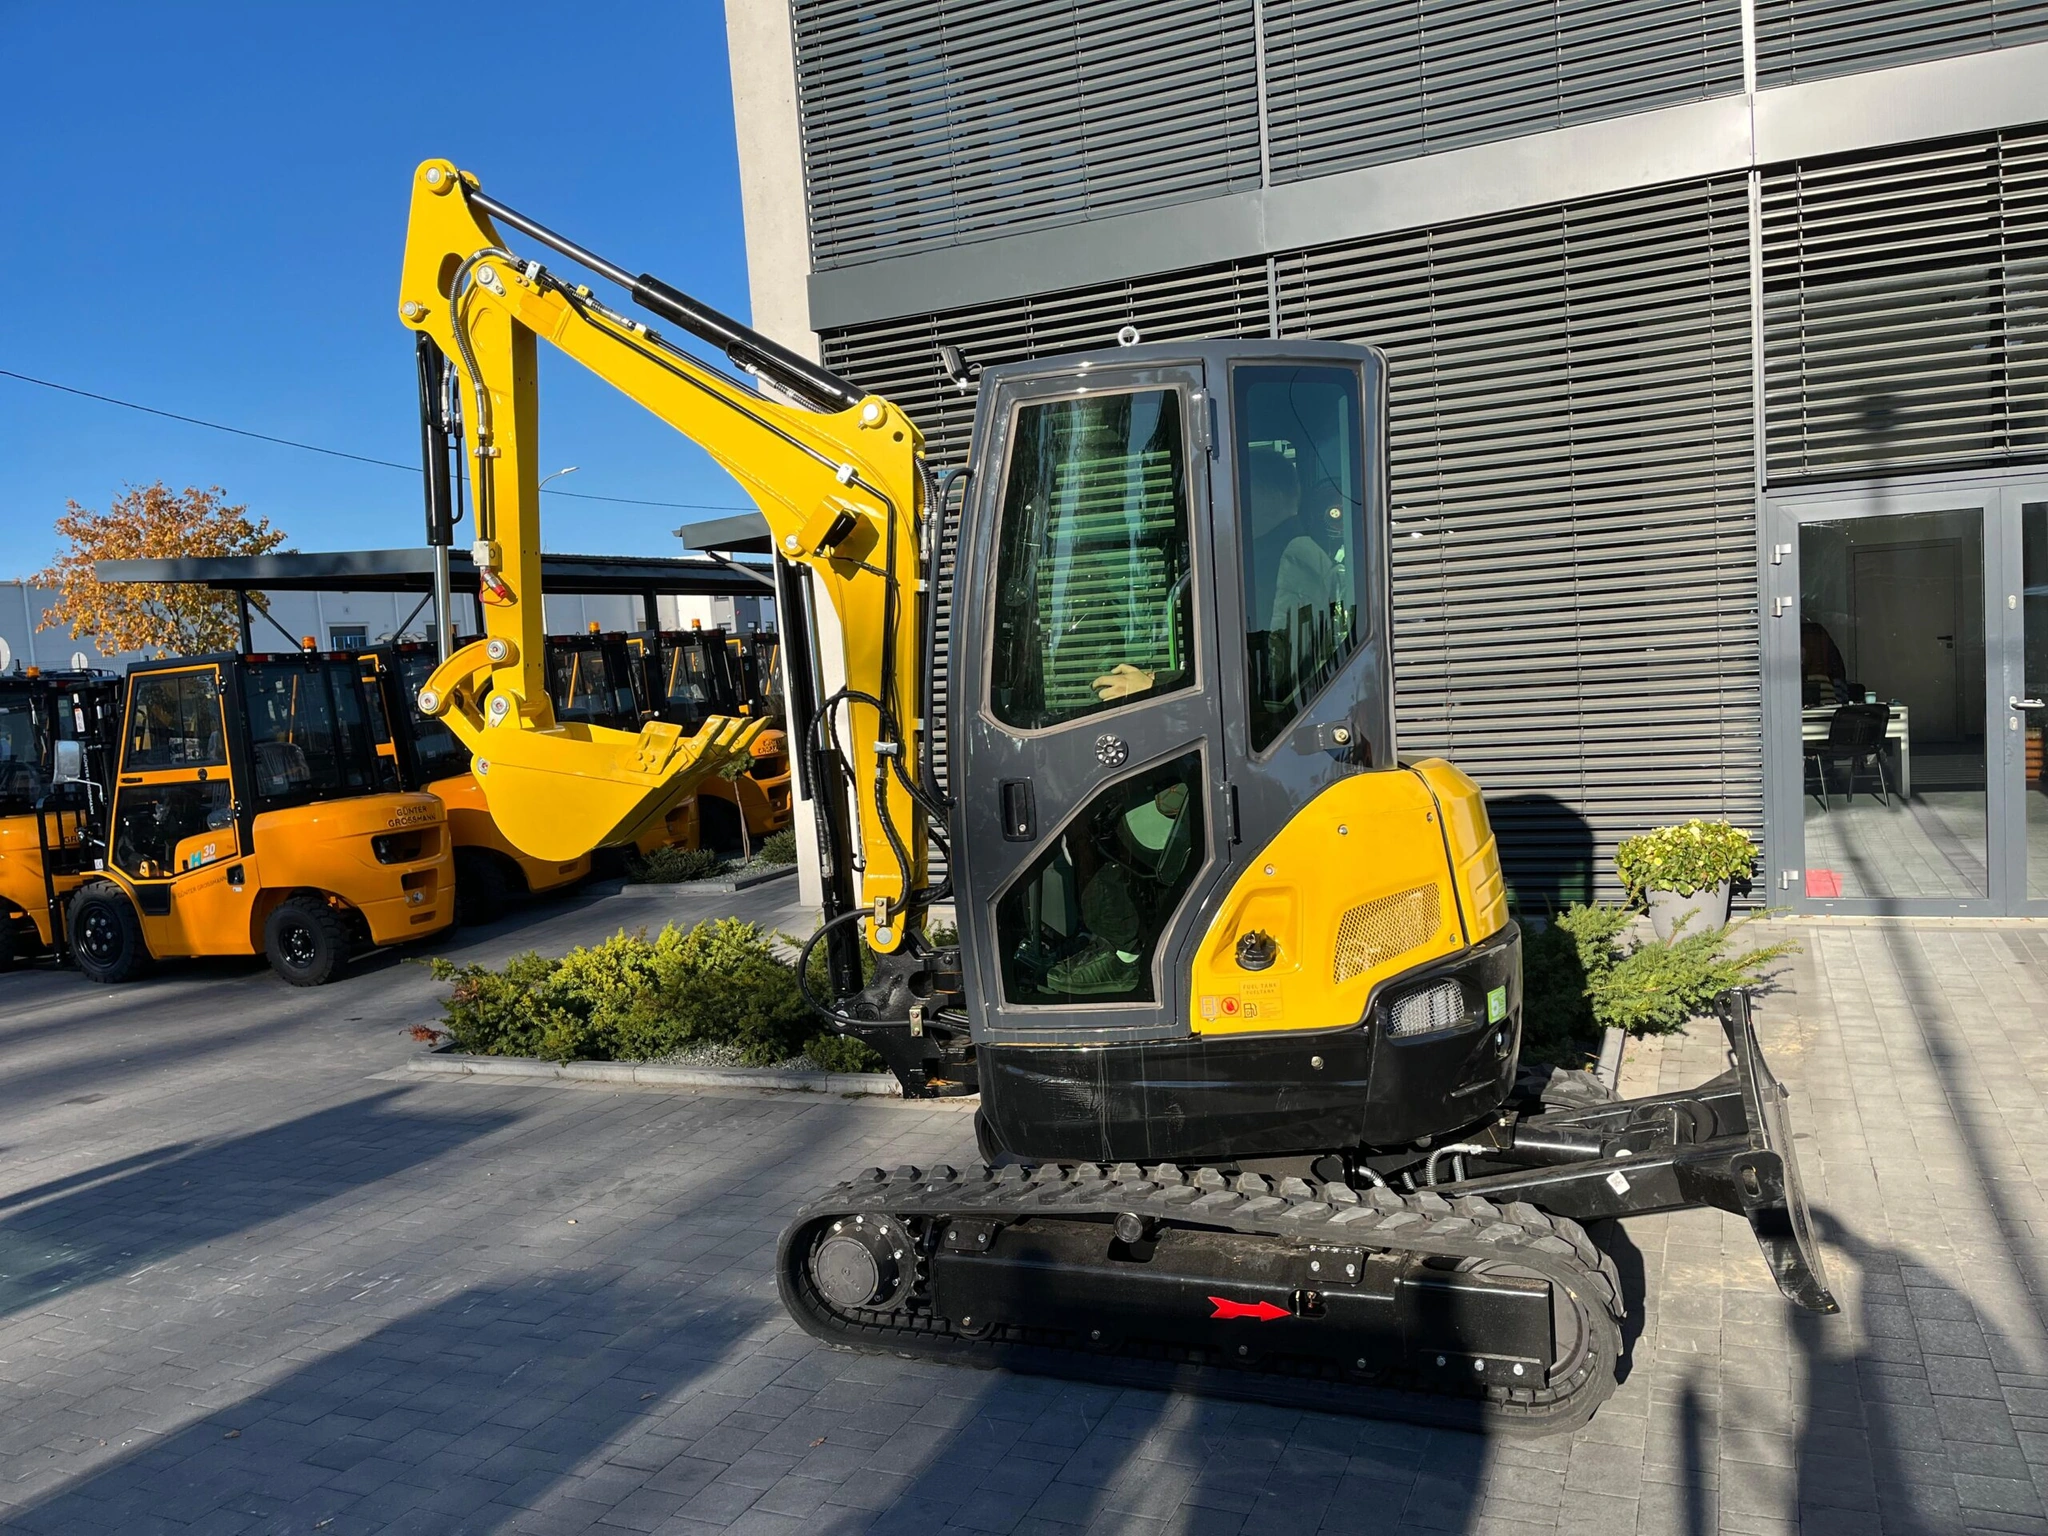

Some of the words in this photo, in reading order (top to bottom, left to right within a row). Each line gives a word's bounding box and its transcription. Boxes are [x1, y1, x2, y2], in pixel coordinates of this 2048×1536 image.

[396, 805, 427, 817] GÜNTER
[388, 813, 436, 828] GROSSMANN
[203, 843, 216, 857] 30
[197, 876, 227, 891] GROSSMANN
